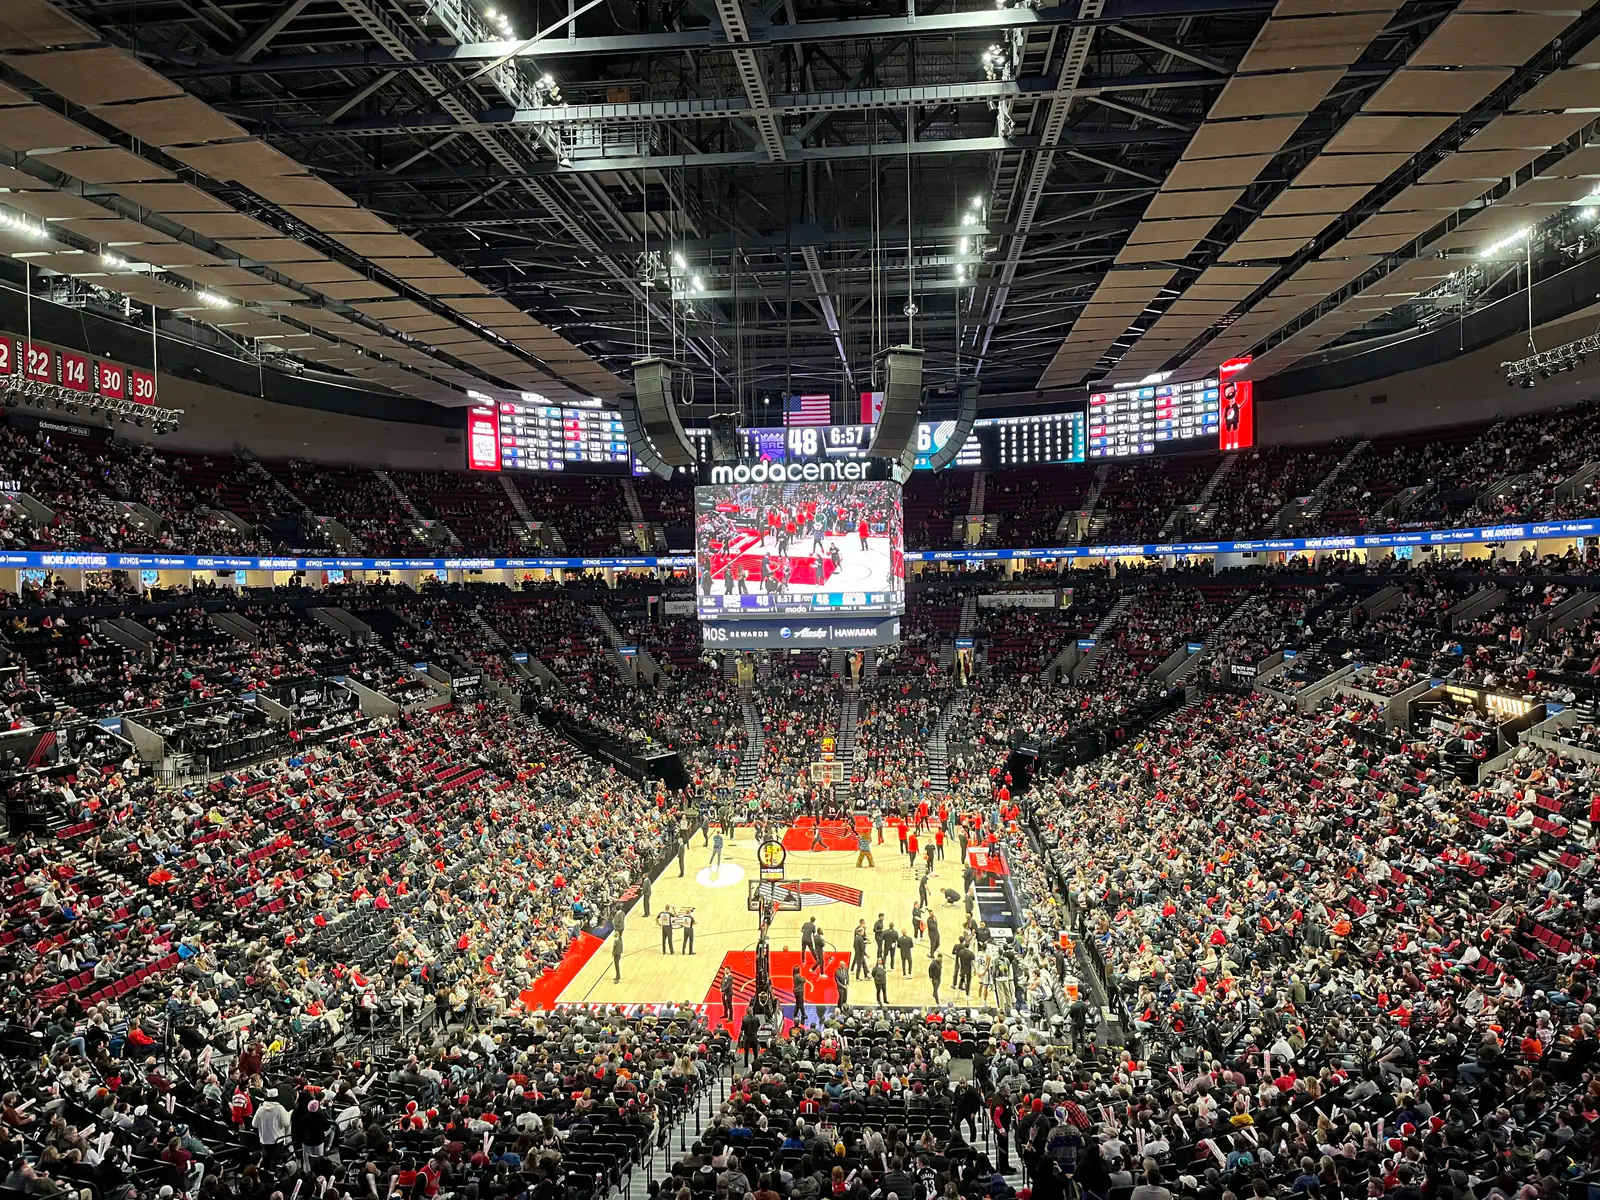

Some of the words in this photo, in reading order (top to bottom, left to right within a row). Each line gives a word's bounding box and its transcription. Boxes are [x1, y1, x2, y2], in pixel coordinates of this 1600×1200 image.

[28, 350, 48, 377] 22
[66, 360, 85, 384] 14
[102, 370, 120, 390] 30
[136, 378, 152, 398] 30
[40, 420, 68, 432] ticketmaster
[788, 429, 817, 455] 48
[830, 428, 864, 444] 6:57
[918, 424, 931, 450] 6
[1106, 546, 1144, 554] ADVENTURES
[43, 556, 64, 565] MORE
[65, 556, 107, 565] ADVENTURES
[756, 596, 768, 606] 48
[816, 593, 829, 604] 46
[794, 627, 827, 638] Alaska
[835, 628, 877, 637] HAWAIIAN
[923, 1180, 935, 1191] 33
